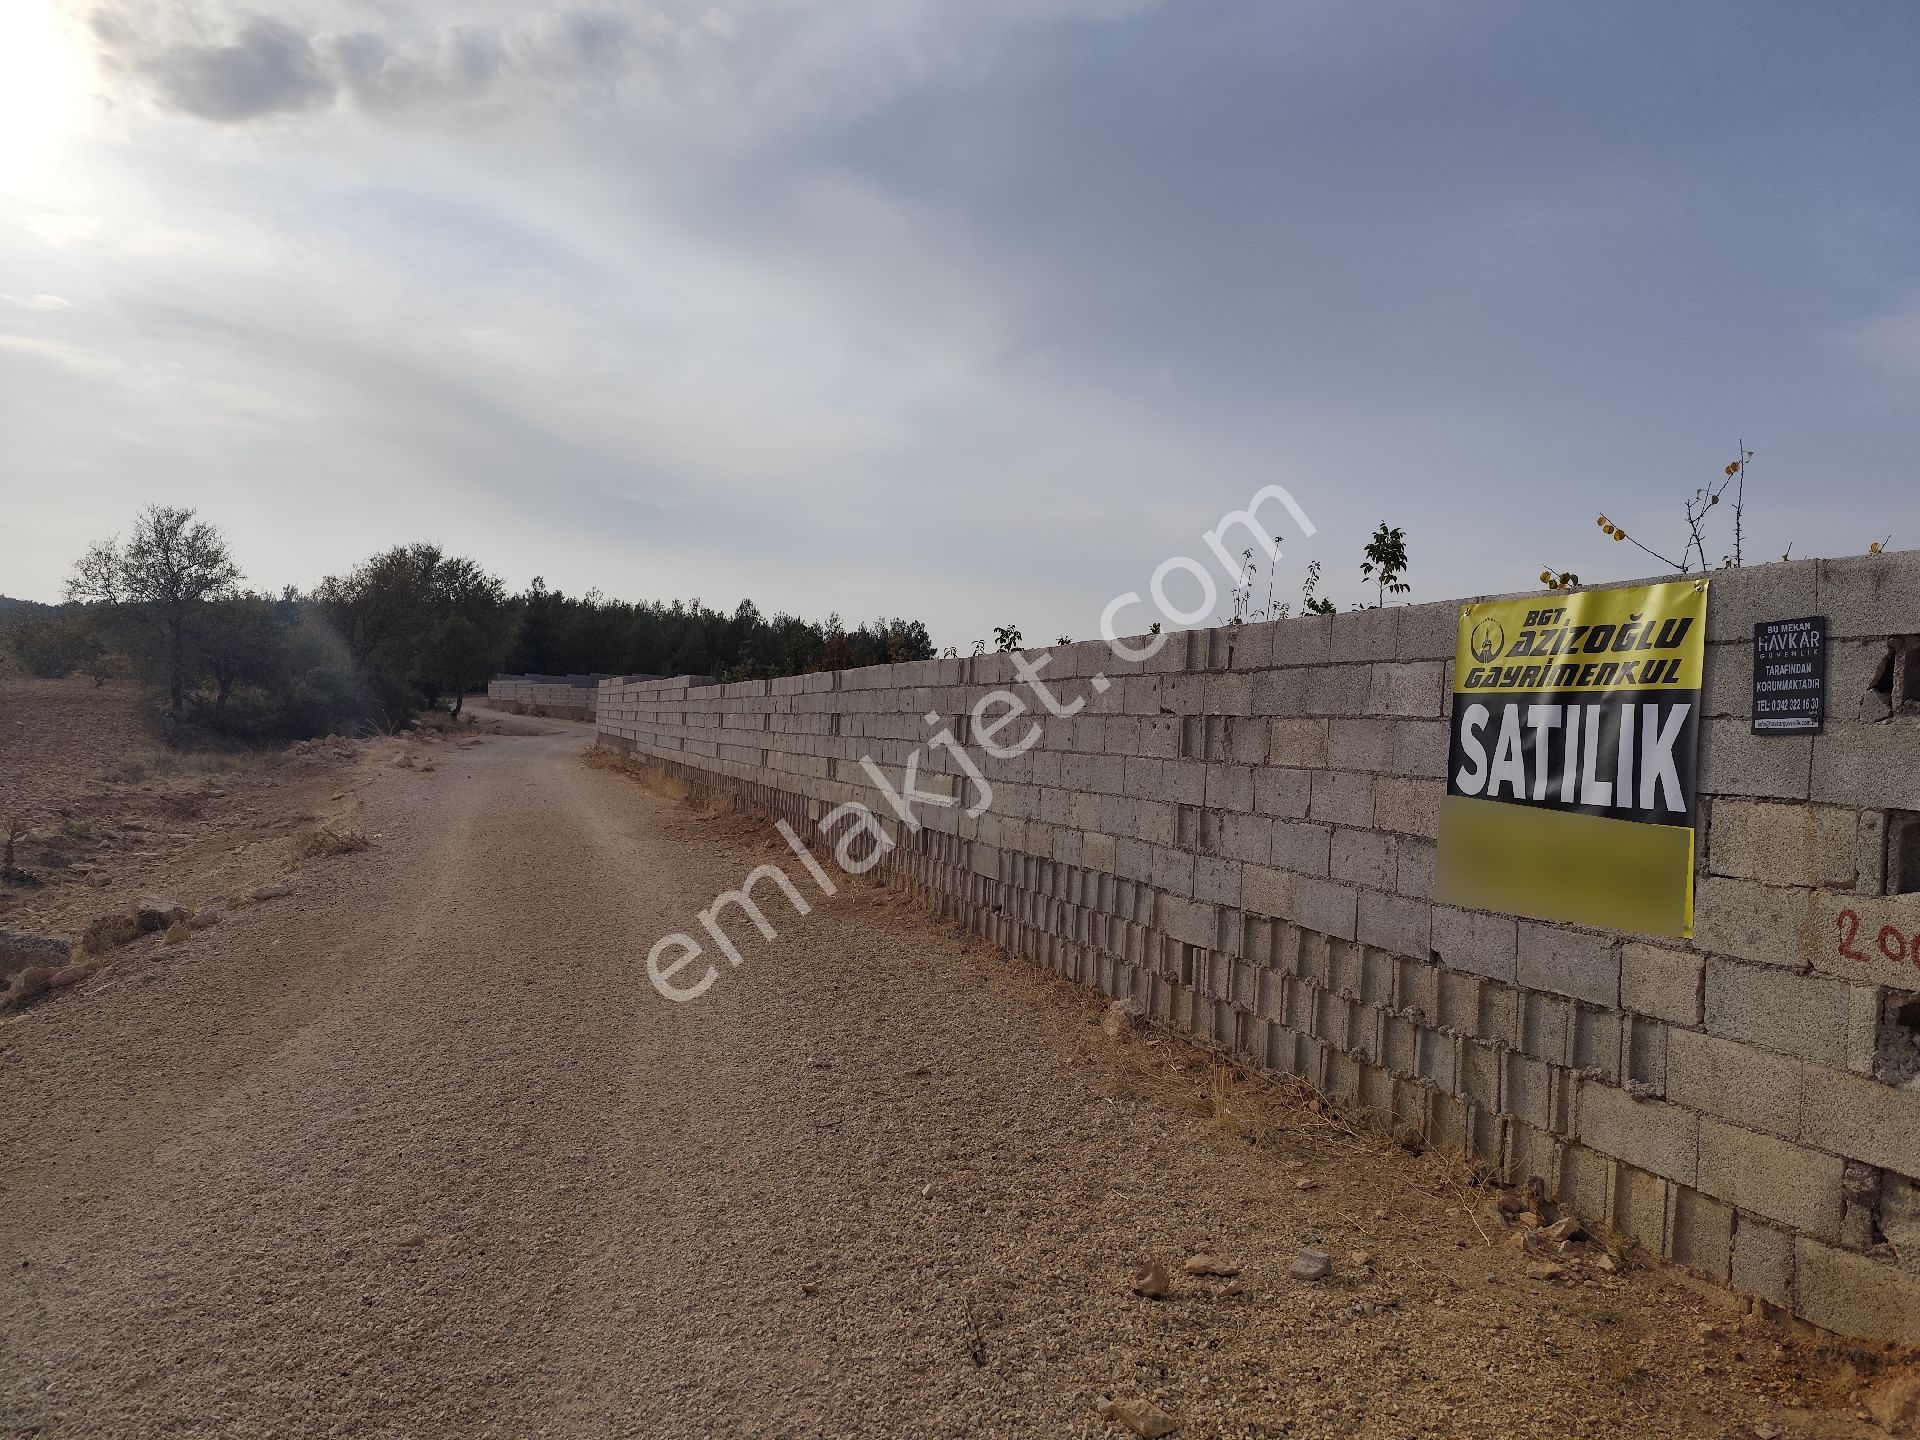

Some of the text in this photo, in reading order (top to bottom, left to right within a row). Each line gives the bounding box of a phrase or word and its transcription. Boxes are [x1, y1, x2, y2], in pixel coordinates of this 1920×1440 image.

[1523, 608, 1567, 627] BGT
[1505, 612, 1695, 657] AZİZOĞLU
[1767, 622, 1811, 634] BU MEKAN
[1758, 630, 1820, 652] HAVKAR
[1760, 649, 1818, 659] GÜVENLİK
[1464, 658, 1682, 688] GAYRİMENKUL
[1765, 662, 1812, 676] TARAFINDAN
[1756, 678, 1820, 692] KORUNMAKTADIR
[1802, 698, 1810, 710] 16
[1455, 703, 1692, 813] SATILIK
